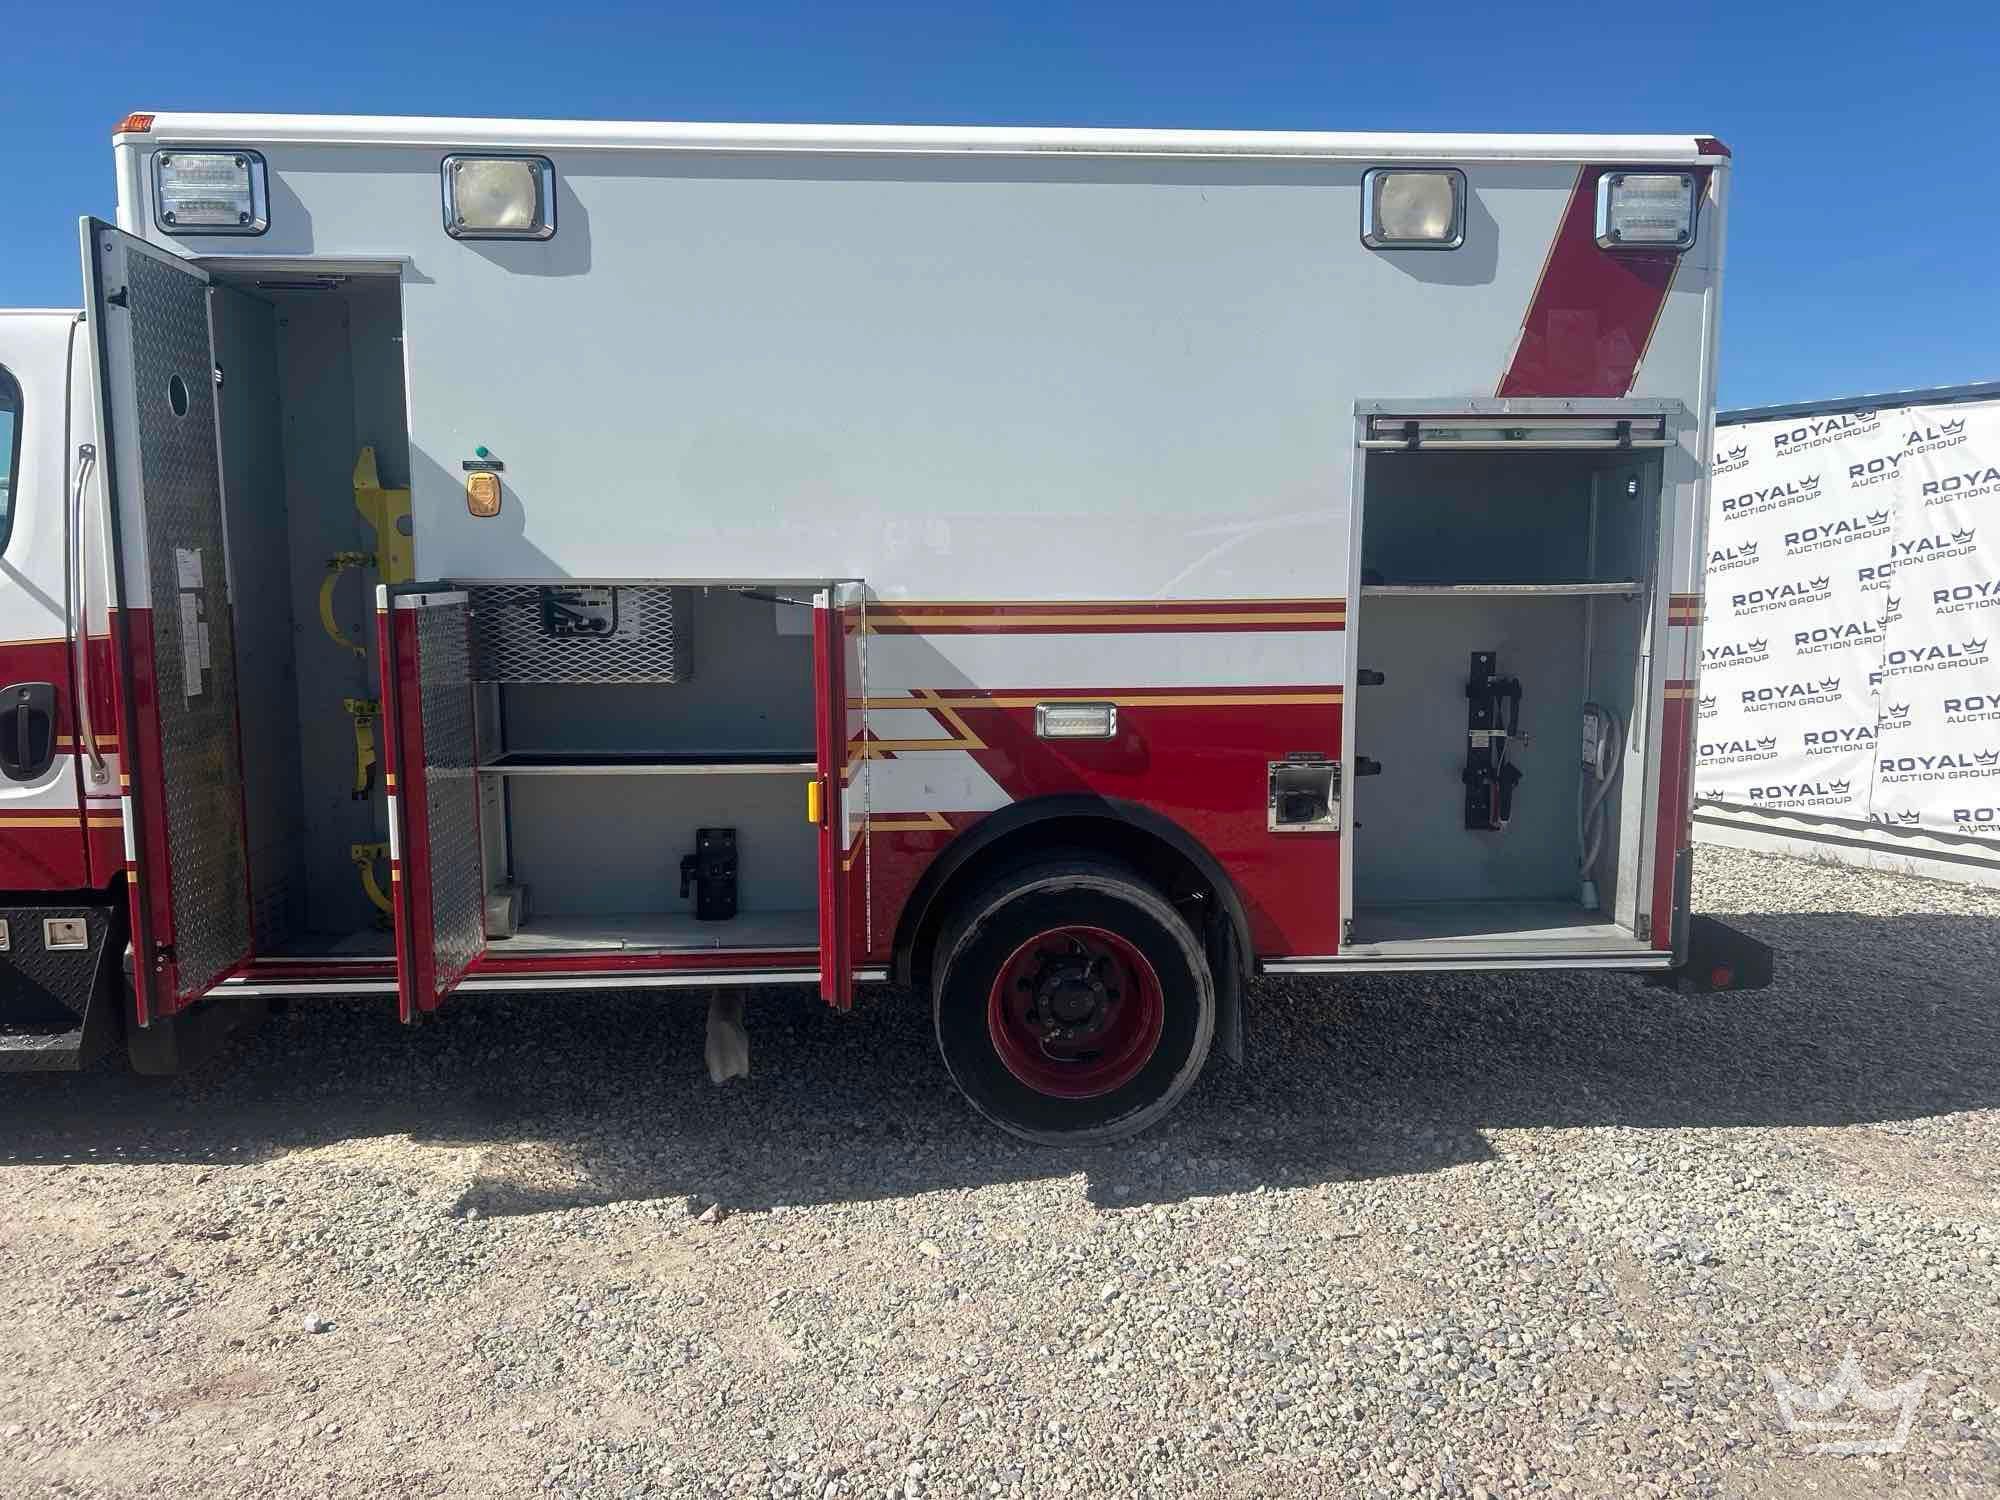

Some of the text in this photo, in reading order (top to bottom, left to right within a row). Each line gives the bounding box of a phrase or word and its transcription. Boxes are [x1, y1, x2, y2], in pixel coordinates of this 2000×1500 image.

[1774, 415, 1855, 448] ROYAL
[1776, 436, 1831, 457] AUCTION
[1834, 422, 1881, 441] GROUP
[1917, 435, 1968, 454] GROUP
[1849, 453, 1902, 478] ROY
[1851, 470, 1901, 488] AUCTIO
[1922, 467, 2000, 496] ROYA
[1722, 483, 1799, 512] ROYAL
[1725, 490, 1822, 521] AUCTION GROUP
[1924, 486, 1991, 507] AUCTION
[1784, 518, 1866, 546] ROYAL
[1787, 526, 1891, 556] AUCTION GROUP
[1891, 535, 1951, 558] YAL
[1891, 545, 1977, 567] TION GROUP
[1719, 557, 1760, 572] GROUP
[1732, 582, 1809, 607] ROYAL
[1933, 579, 2000, 604] ROY
[1734, 592, 1832, 616] AUCTION GROUP
[1795, 621, 1876, 645] ROYAL
[1701, 643, 1748, 661] YAL
[1797, 635, 1884, 655] AUCTION GRO
[1884, 644, 1962, 665] OYAL
[1700, 654, 1769, 671] TION GROUP
[1882, 656, 1989, 677] UCTION GROUP
[1741, 682, 1819, 703] ROYAL
[1743, 693, 1842, 713] AUCTION GROUP
[1944, 694, 2000, 713] ROY
[1878, 720, 1911, 730] ROUP
[1946, 711, 2000, 724] AUCTIO
[1698, 739, 1757, 756] OYAL
[1737, 752, 1778, 762] GROUP
[1806, 743, 1863, 756] AUCTION
[1880, 754, 1973, 772] ROYAL
[1881, 768, 2000, 783] AUCTION GROUP
[1749, 783, 1829, 799] ROYAL
[1807, 796, 1852, 806] GROUP
